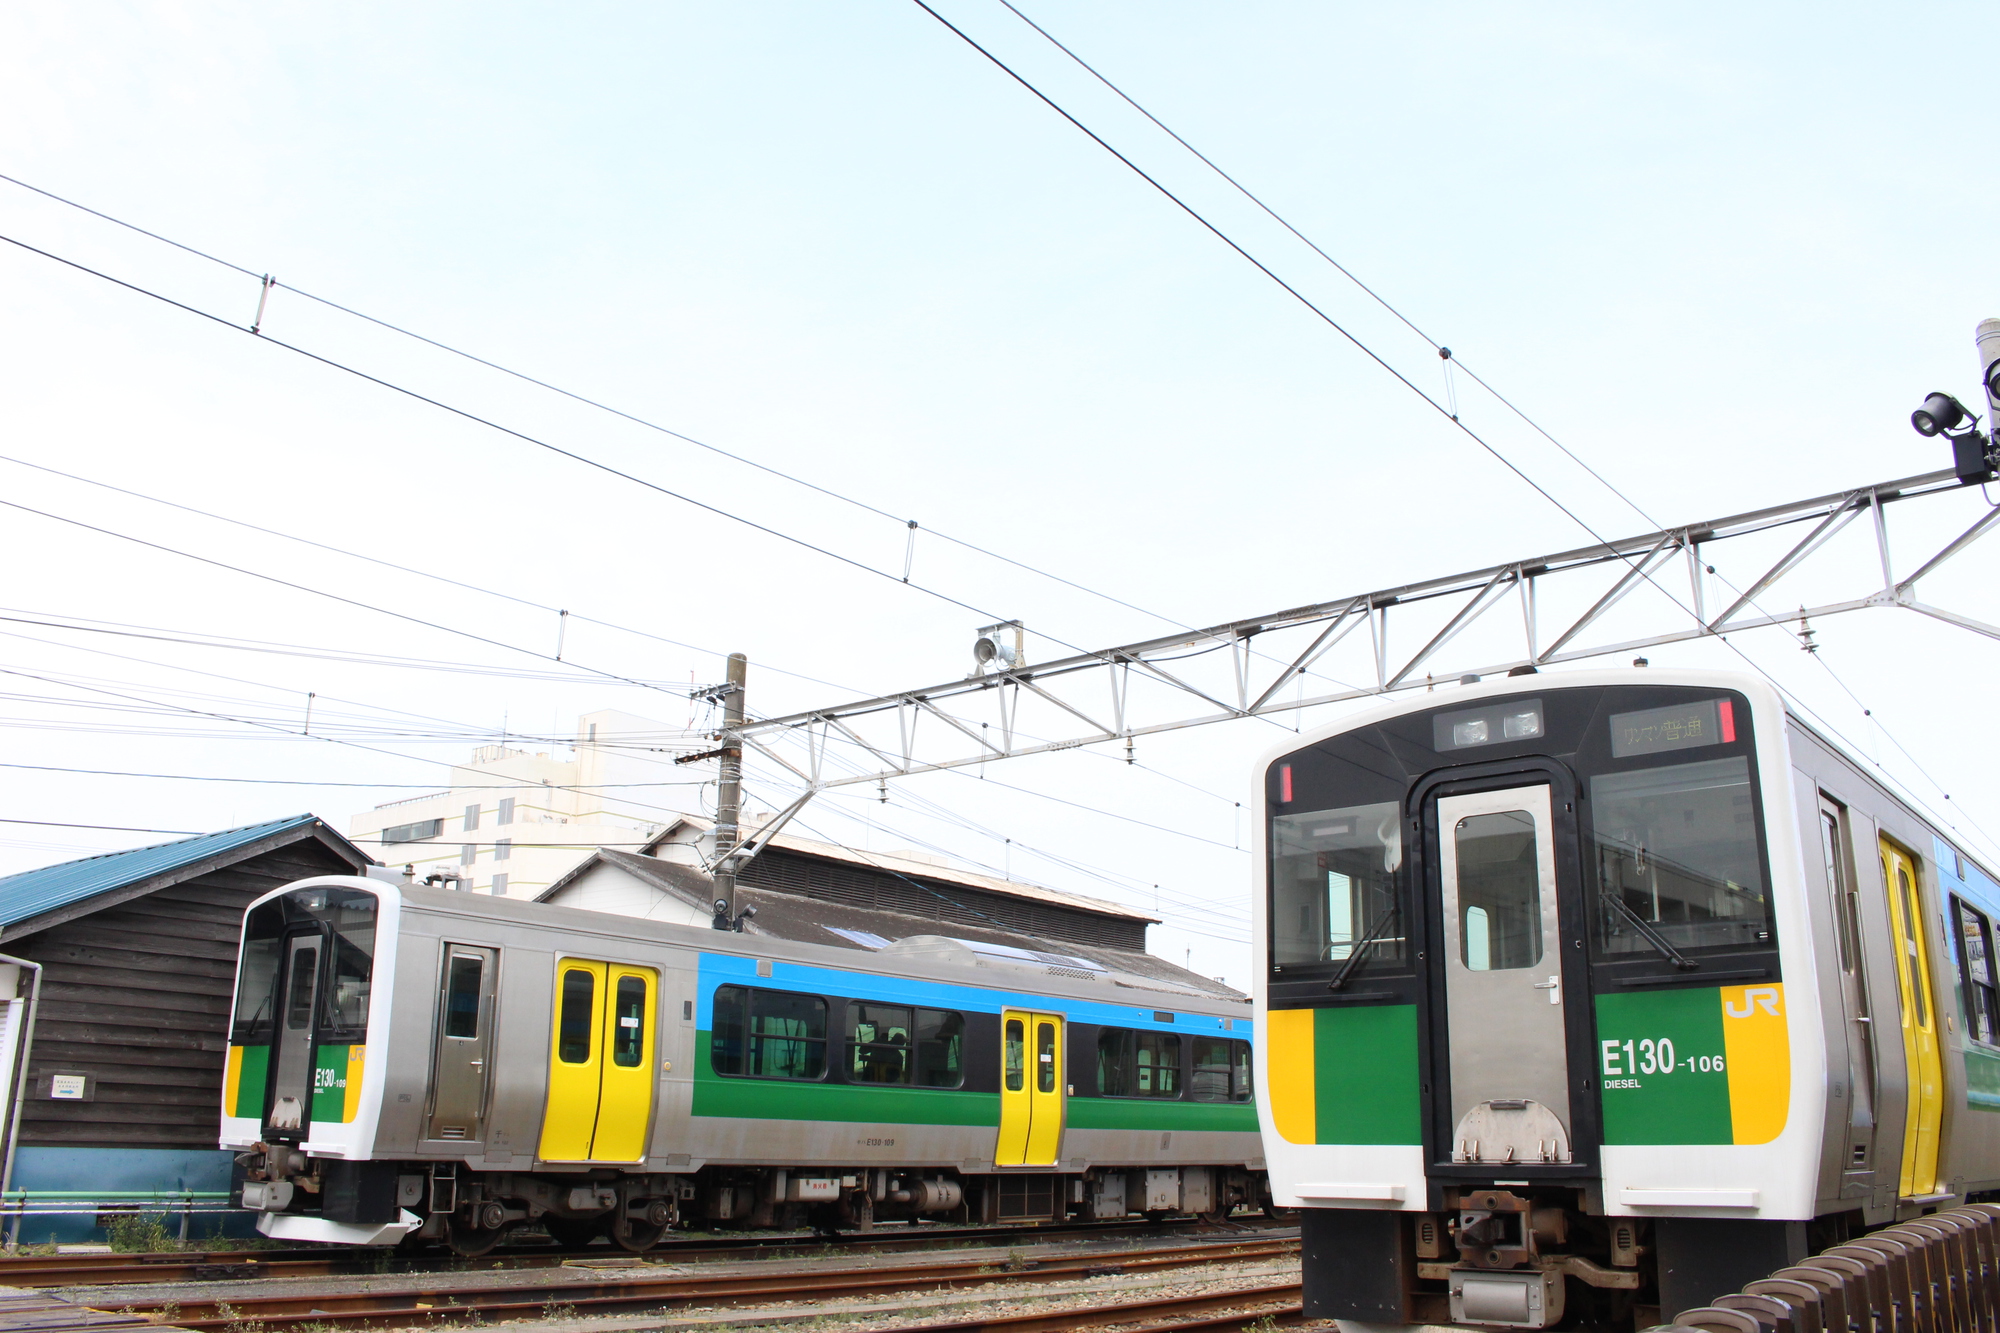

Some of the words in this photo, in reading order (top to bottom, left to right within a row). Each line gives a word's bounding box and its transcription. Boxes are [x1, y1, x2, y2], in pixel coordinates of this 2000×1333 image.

[1725, 987, 1781, 1019] JR
[350, 1047, 365, 1061] JR
[1604, 1078, 1642, 1089] DIESEL
